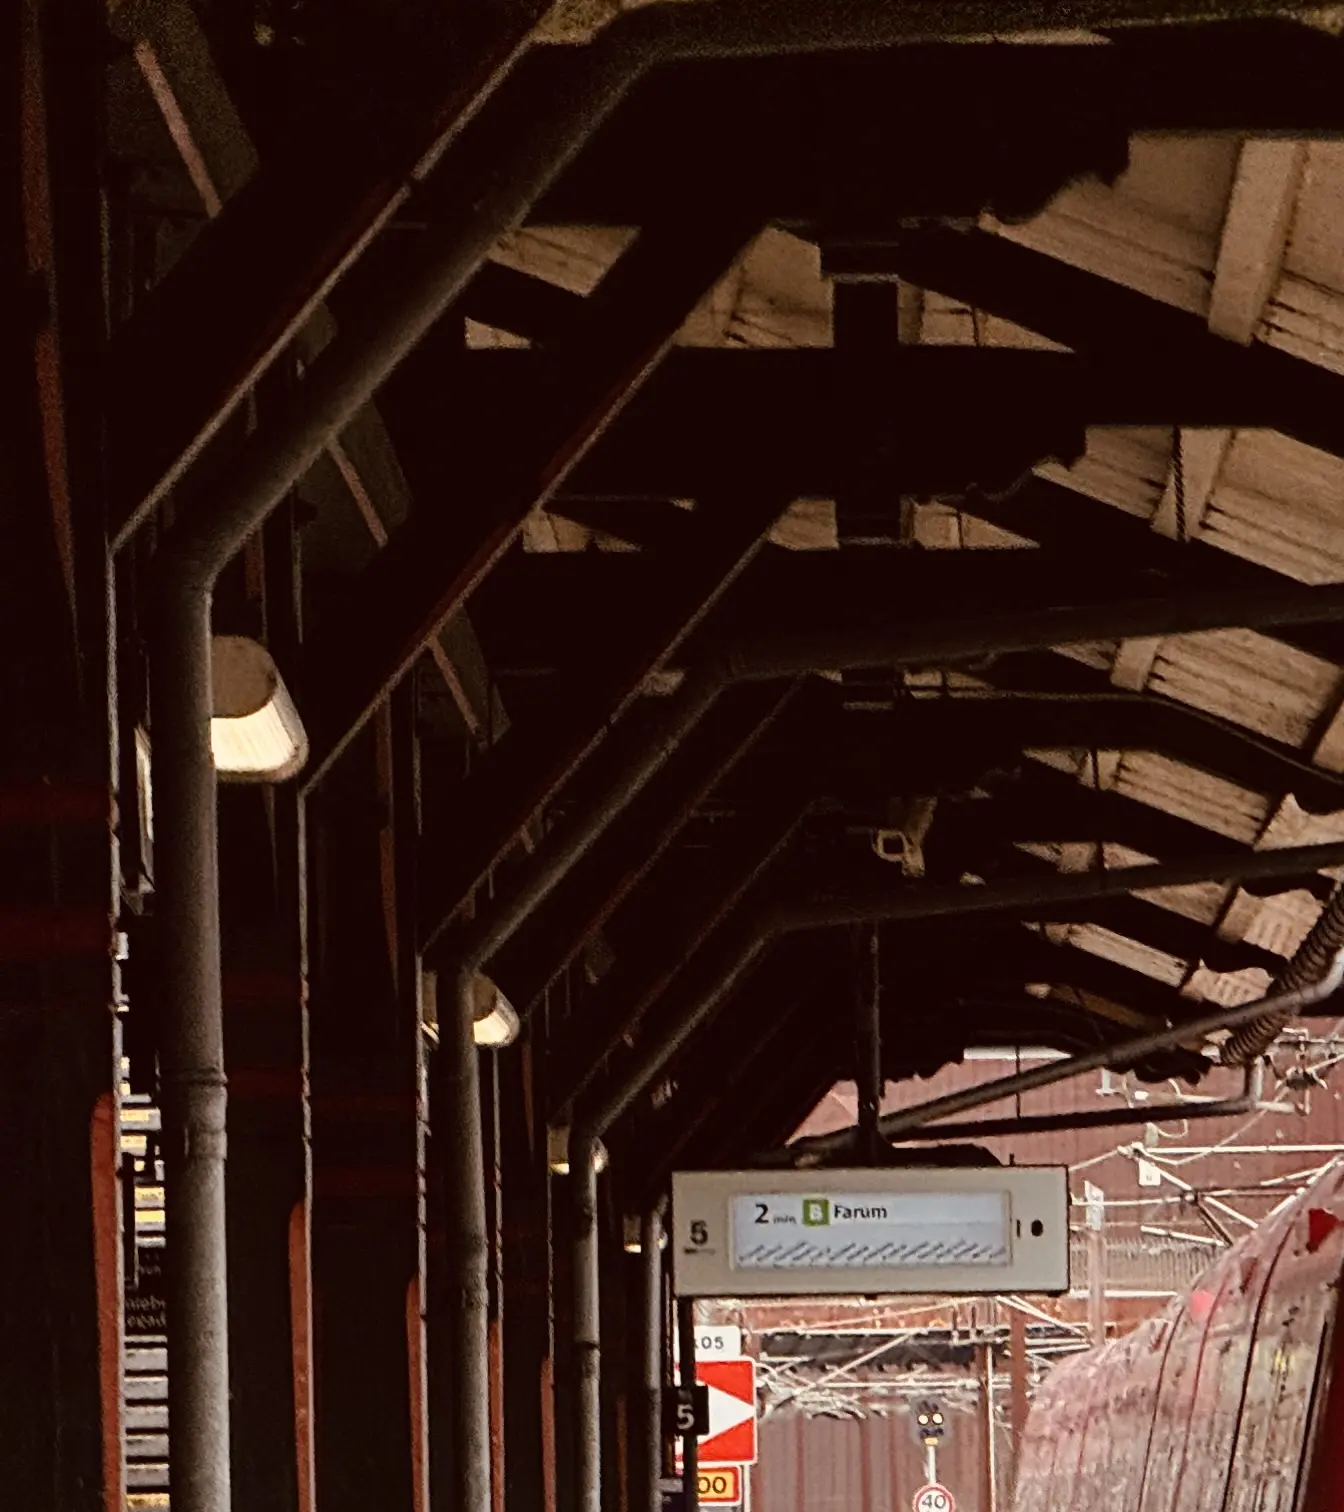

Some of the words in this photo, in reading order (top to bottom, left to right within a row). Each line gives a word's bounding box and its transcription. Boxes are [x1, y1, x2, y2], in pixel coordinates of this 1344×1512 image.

[754, 1203, 769, 1224] 2
[834, 1204, 888, 1219] Farum
[676, 1404, 696, 1430] 5
[921, 1494, 947, 1509] 40
